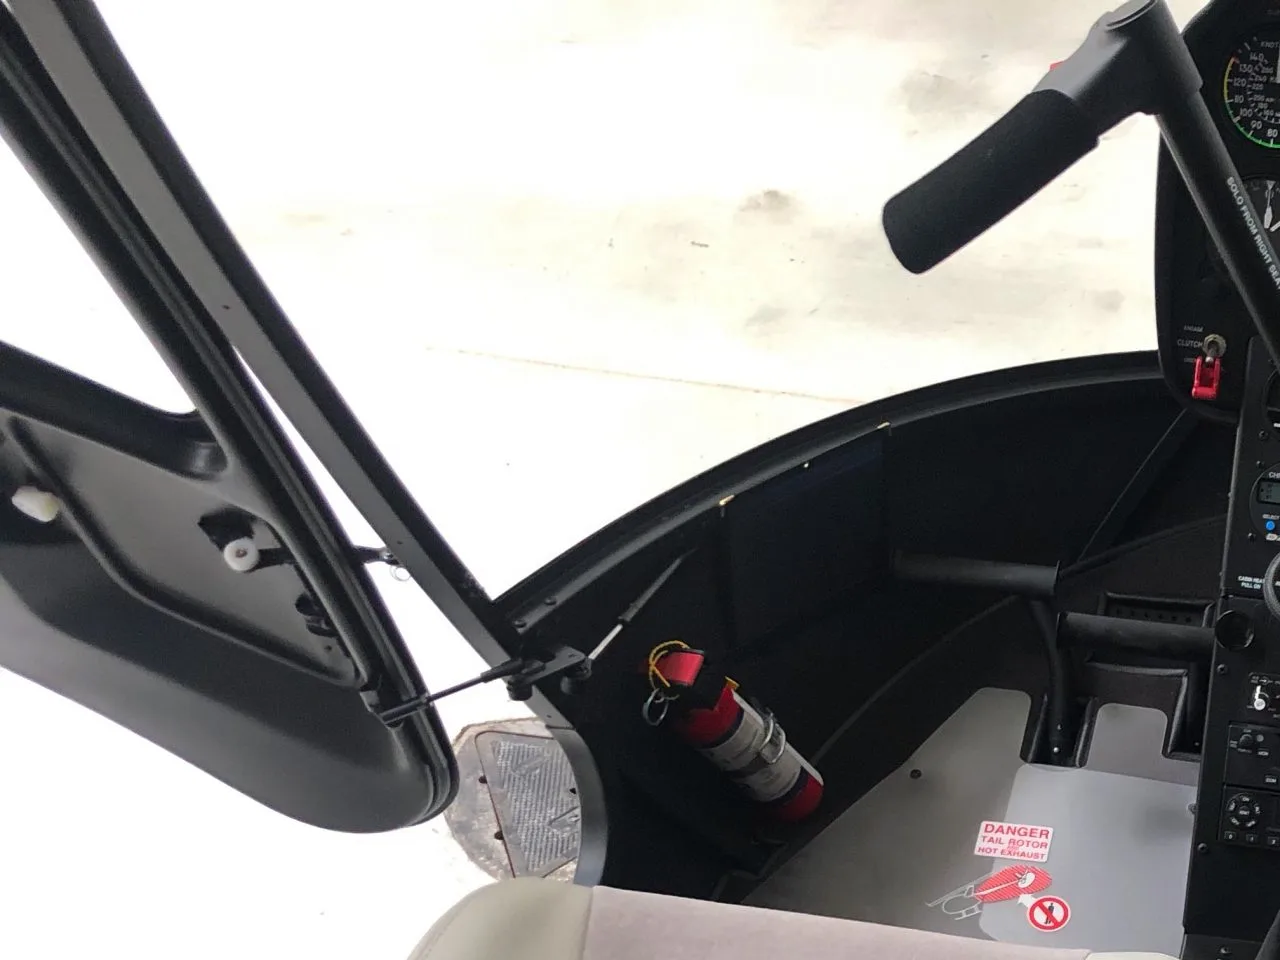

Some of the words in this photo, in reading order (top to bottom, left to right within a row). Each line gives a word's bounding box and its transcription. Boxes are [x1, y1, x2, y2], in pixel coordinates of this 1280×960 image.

[1239, 64, 1253, 73] 130
[1233, 78, 1246, 87] 120
[1250, 120, 1262, 130] 90
[1267, 128, 1278, 138] 80
[1227, 176, 1244, 205] SOLO
[1240, 205, 1258, 235] FROM
[1254, 234, 1273, 264] RIGHT
[983, 823, 1050, 839] DANGER
[981, 835, 1005, 845] TAIL
[1008, 838, 1048, 849] ROTOR
[1000, 849, 1047, 860] EXHAUST
